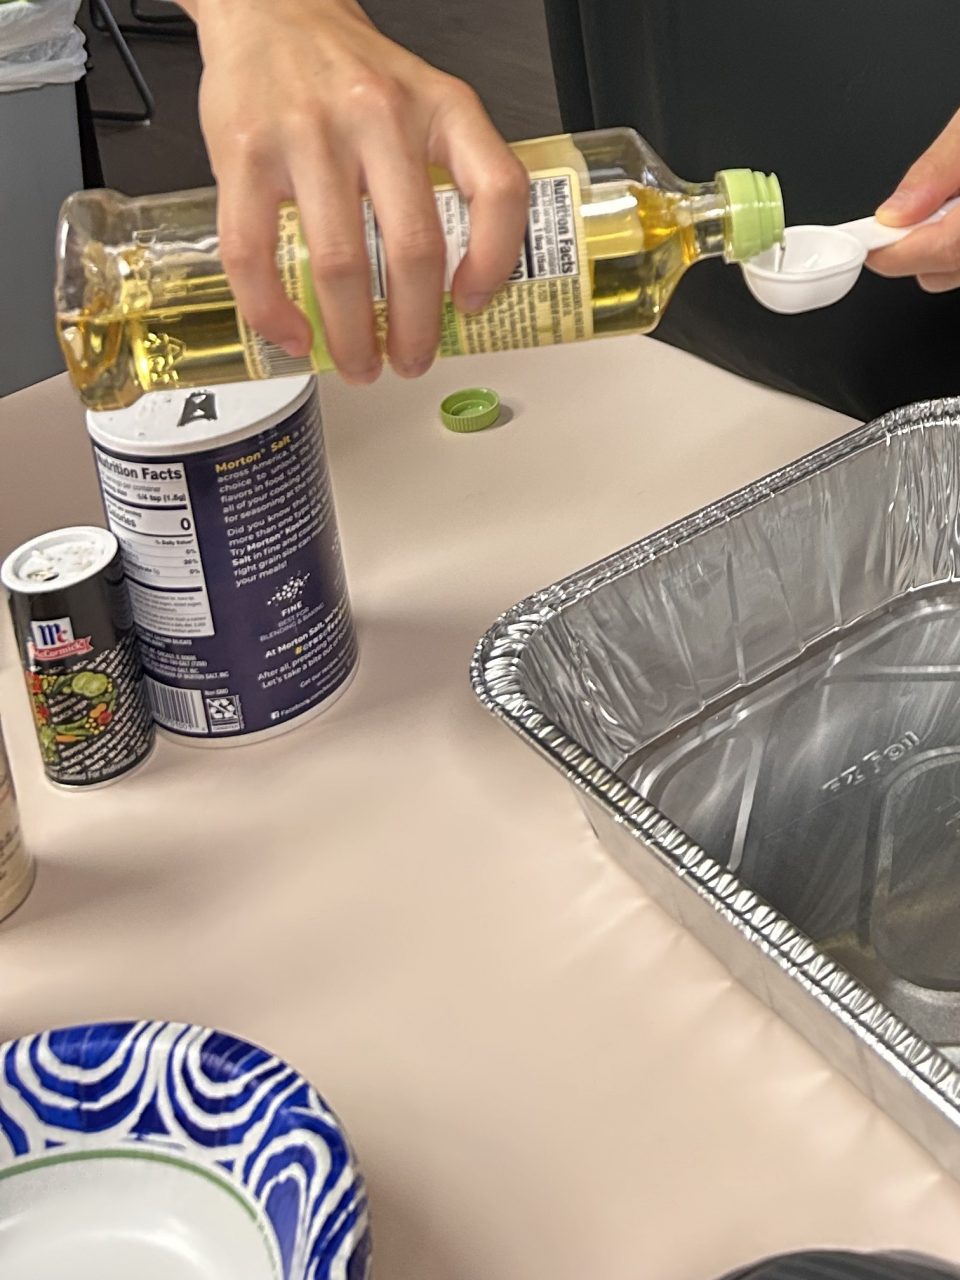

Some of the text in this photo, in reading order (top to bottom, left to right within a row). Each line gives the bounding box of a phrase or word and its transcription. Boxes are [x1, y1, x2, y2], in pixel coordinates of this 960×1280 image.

[553, 179, 575, 273] Nutrition Facts
[270, 435, 291, 453] Salt
[142, 468, 182, 480] Facts
[217, 468, 250, 483] across
[219, 478, 252, 493] choice
[221, 489, 254, 503] flavors
[223, 504, 234, 514] all
[248, 493, 268, 507] your
[224, 515, 238, 524] for
[240, 495, 286, 519] seasoning
[180, 518, 191, 531] 0
[227, 525, 244, 537] Did
[247, 519, 265, 531] you
[267, 506, 291, 522] know
[229, 533, 255, 546] more
[255, 524, 277, 538] than
[229, 547, 245, 557] Try
[232, 555, 252, 567] Salt
[263, 544, 281, 556] fine
[234, 563, 257, 577] right
[258, 554, 281, 570] grain
[236, 574, 257, 588] your
[281, 600, 303, 617] FINE
[265, 648, 276, 659] At
[277, 632, 309, 653] Morton
[258, 669, 279, 681] After
[262, 675, 283, 689] Let's
[283, 666, 301, 680] take
